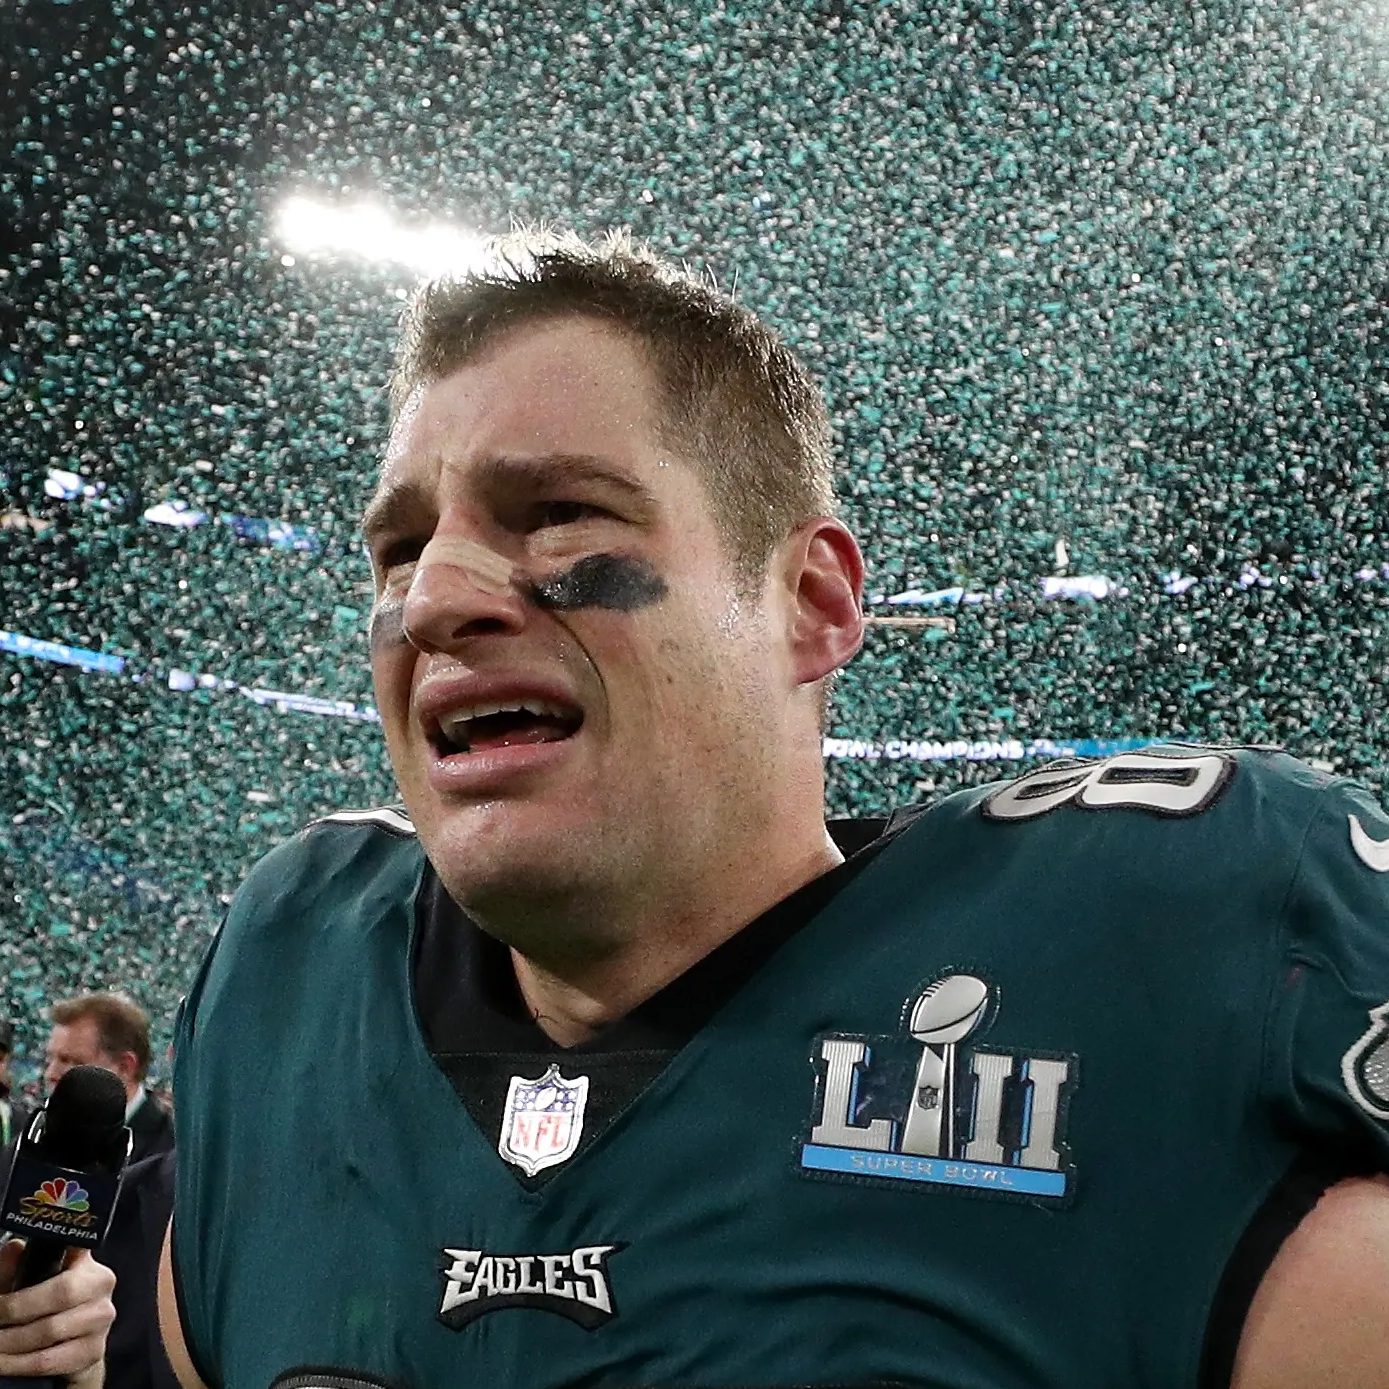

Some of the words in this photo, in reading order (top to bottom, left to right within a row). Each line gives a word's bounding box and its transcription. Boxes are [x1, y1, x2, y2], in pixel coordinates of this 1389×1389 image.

[885, 739, 1024, 760] CHAMPIONS
[811, 1038, 1071, 1170] LII
[513, 1114, 565, 1154] NFL
[850, 1154, 932, 1176] SUPER
[944, 1163, 1013, 1185] BOWL
[5, 1213, 98, 1240] PHILADELPHIA
[19, 1197, 98, 1227] Sports
[440, 1245, 616, 1315] EAGLES
